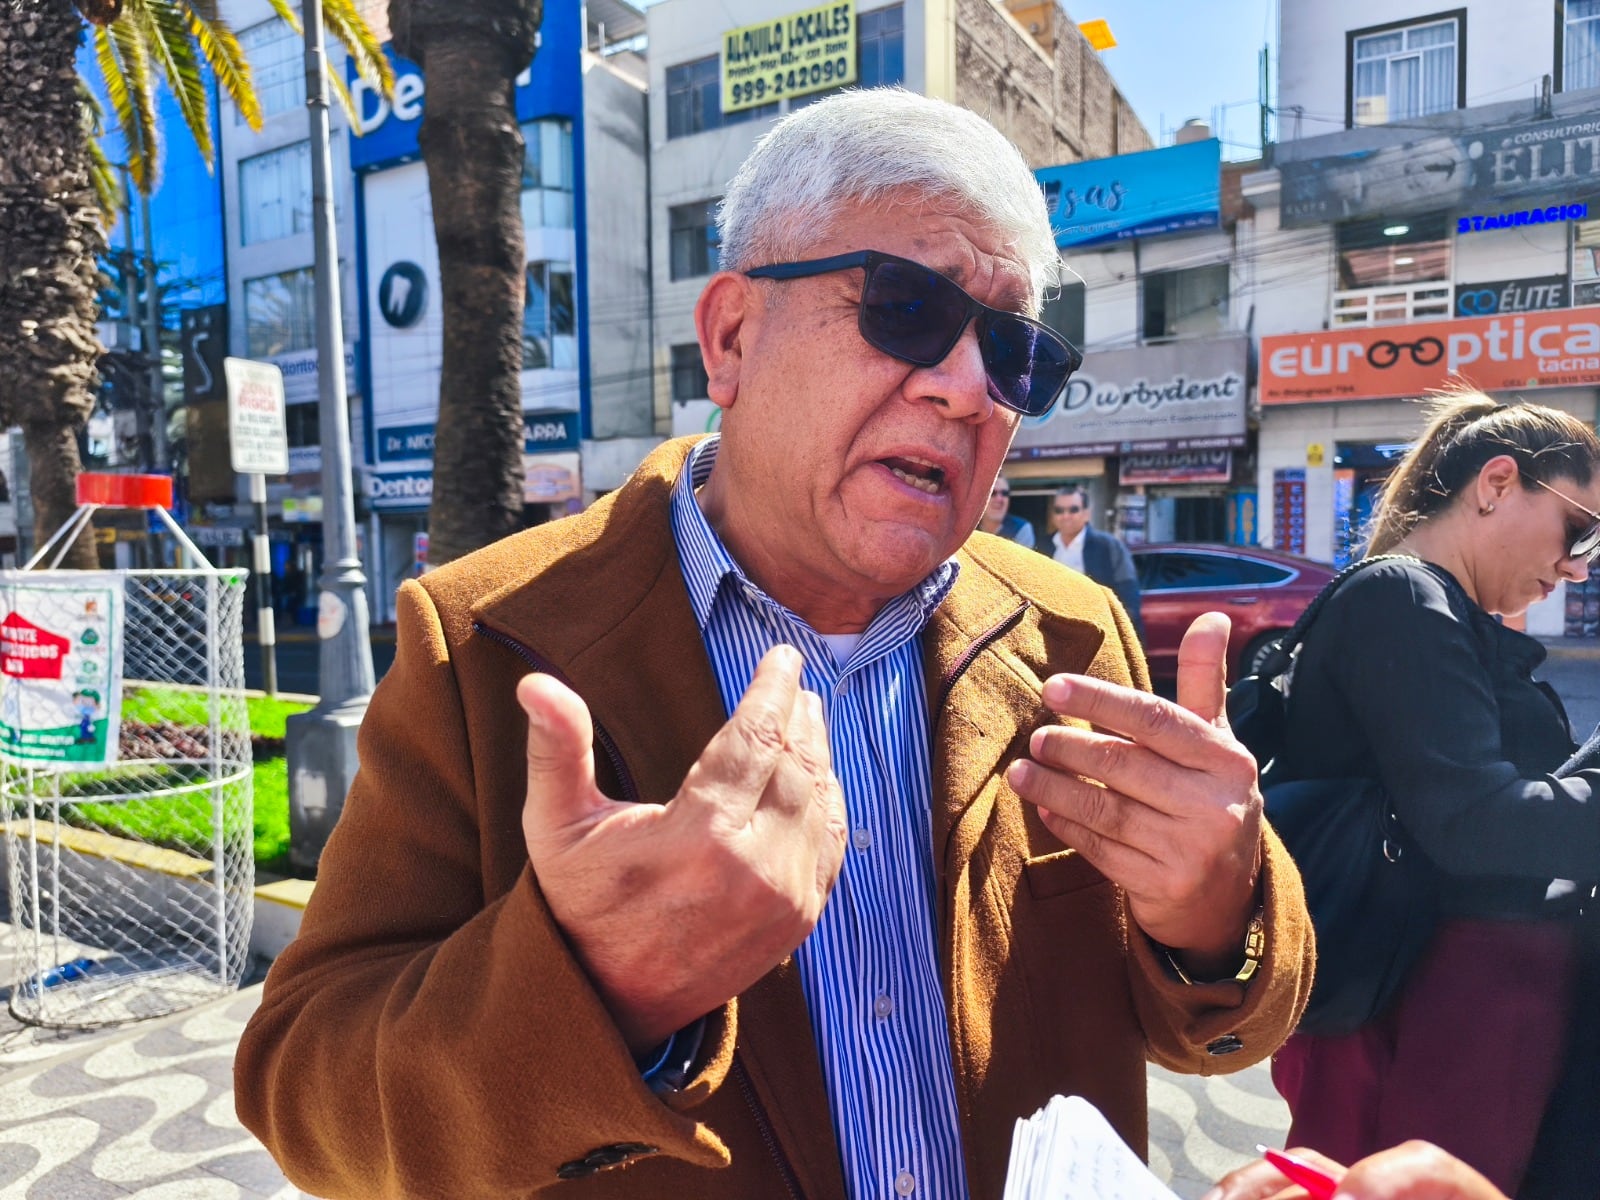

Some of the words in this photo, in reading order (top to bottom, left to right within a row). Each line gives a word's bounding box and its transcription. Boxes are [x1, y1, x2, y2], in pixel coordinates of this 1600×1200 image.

[727, 22, 783, 62] ALQUILO
[788, 4, 849, 48] LOCALES
[732, 56, 847, 105] 999-242090
[1500, 282, 1563, 313] ÉLITE
[1538, 354, 1600, 373] tacna
